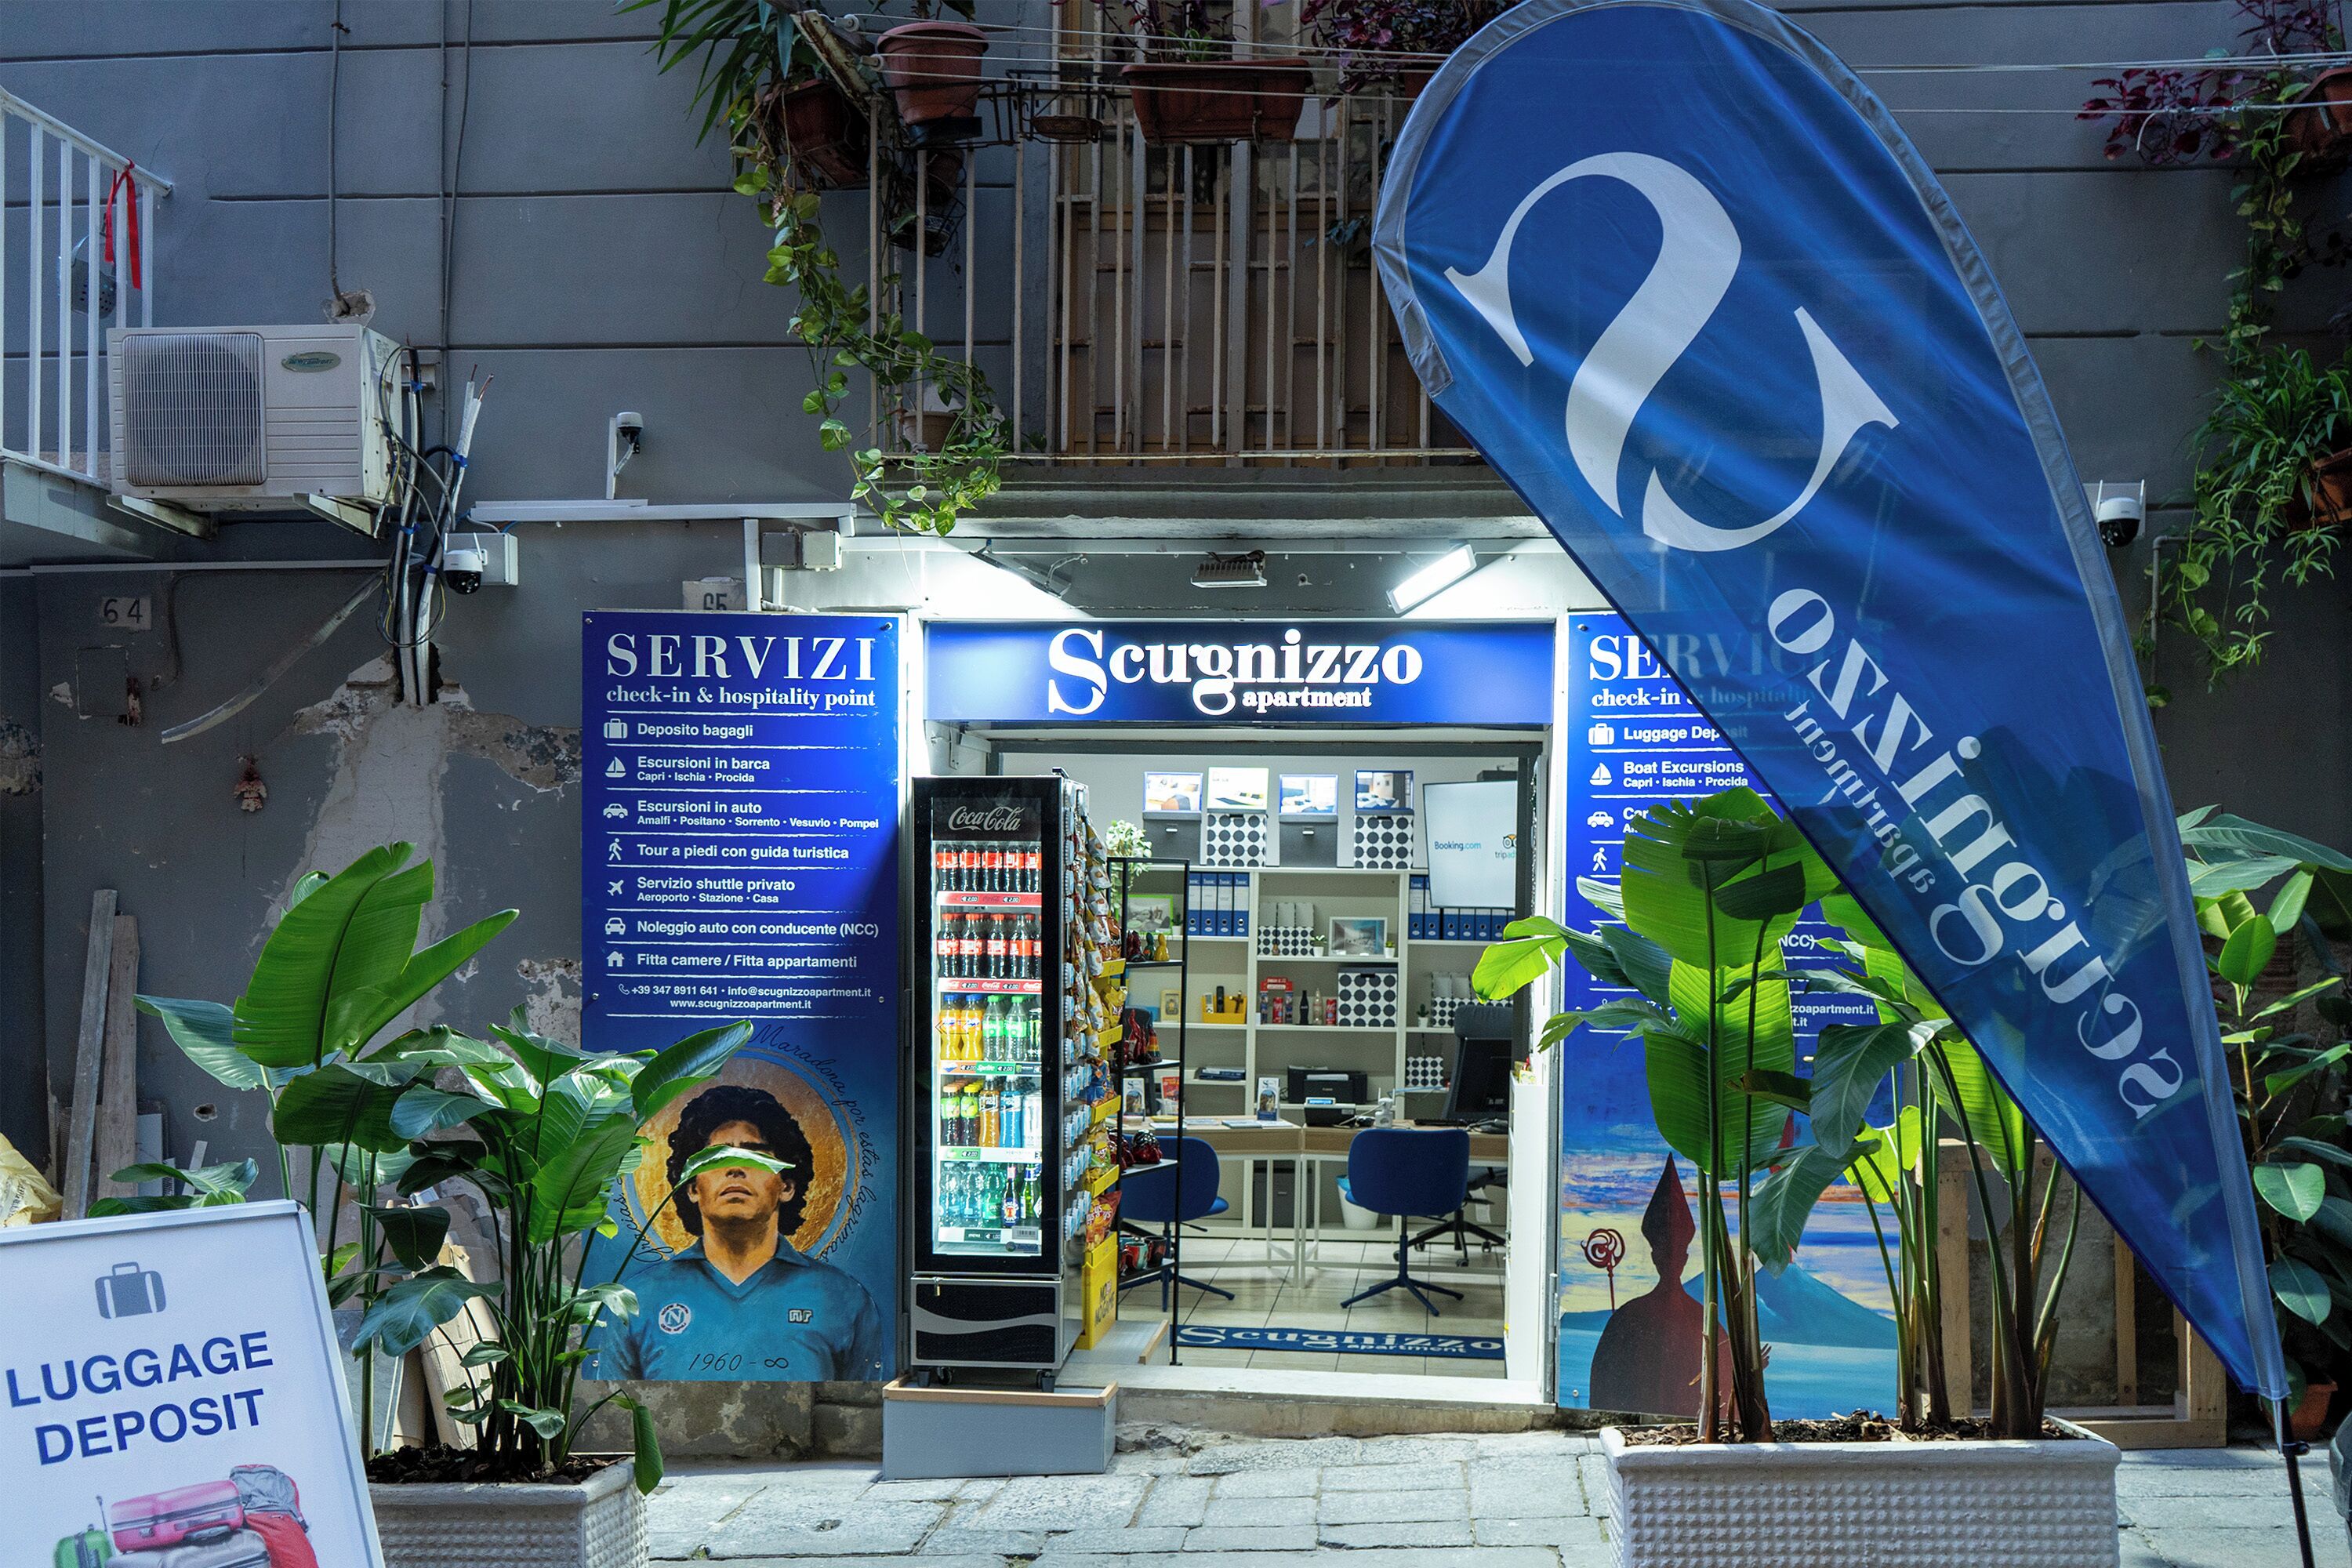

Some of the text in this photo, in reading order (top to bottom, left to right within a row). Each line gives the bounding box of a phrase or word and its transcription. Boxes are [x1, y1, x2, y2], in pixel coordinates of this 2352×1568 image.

[103, 598, 143, 624] 64
[607, 633, 876, 681] SERVIZI
[1048, 628, 1423, 715] Scugnizzo
[607, 685, 876, 710] check-in & hospitality point
[1243, 687, 1372, 713] apartment
[1592, 687, 1680, 706] check-in
[637, 723, 753, 739] Deposito bagagli
[1624, 727, 1687, 742] Luggage
[637, 757, 771, 770] Escursioni in barca
[1624, 761, 1744, 774] Boat Excursions
[637, 771, 755, 783] Capri Ischia Procida
[1623, 776, 1748, 789] Capri Ischia Procida
[637, 800, 762, 815] Escursioni in auto
[637, 816, 879, 829] Amalfi Positano Sorrento Vesuvio Pompei
[637, 844, 849, 861] Tour a piedi con guida turistica
[1434, 841, 1481, 851] Booking.com
[637, 877, 795, 894] Servizio shuttle privato
[637, 893, 779, 903] Aeroporto Stazione Casa
[637, 921, 879, 938] Noleggio auto con conducente (NCC)
[1779, 934, 1815, 950] NCC)
[637, 954, 857, 971] Fitta camere / Fitta appartamenti
[632, 986, 871, 998] +39 347 8911 641 info@scugnizzoapartment.it
[670, 999, 811, 1011] www.scugnizzoapartment.it
[1177, 1326, 1502, 1349] Scugnizzo
[1347, 1343, 1467, 1354] apartment
[6, 1331, 273, 1407] LUGGAGE
[689, 1353, 742, 1371] 1960
[35, 1388, 264, 1465] DEPOSIT
